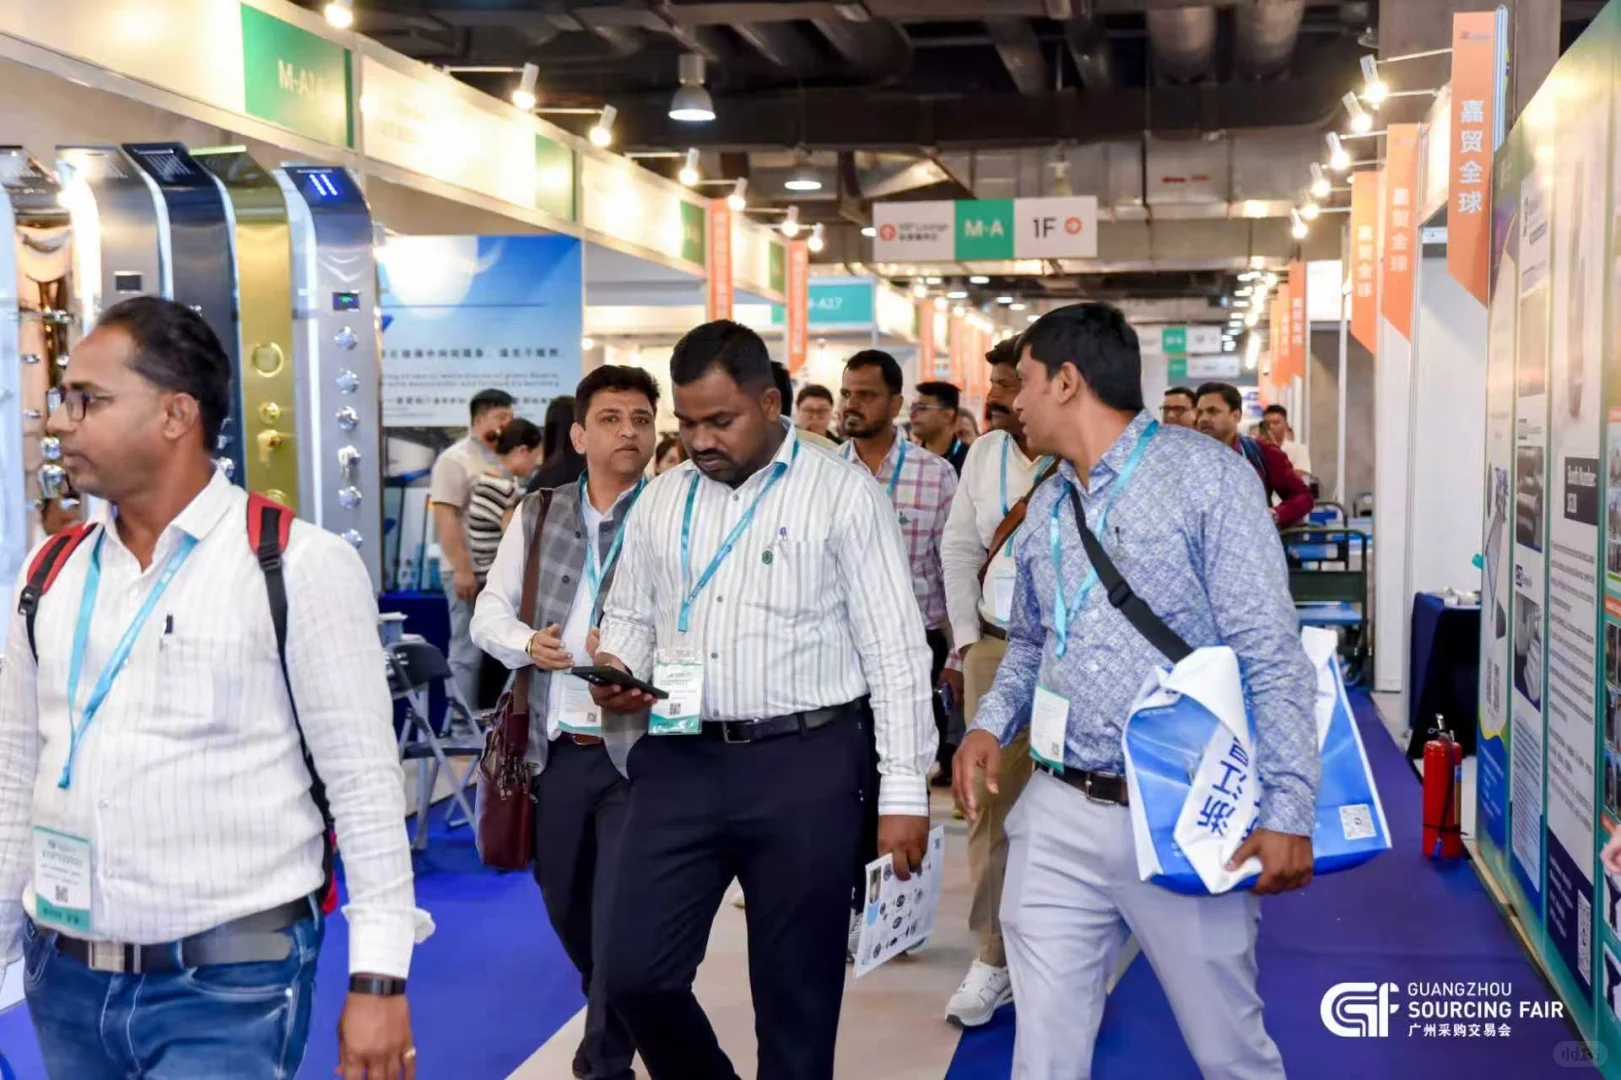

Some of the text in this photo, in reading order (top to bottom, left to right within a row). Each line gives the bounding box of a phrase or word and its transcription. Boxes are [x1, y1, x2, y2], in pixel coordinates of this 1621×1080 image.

[1458, 100, 1484, 215] 嘉贸全球
[1032, 217, 1057, 239] 1F
